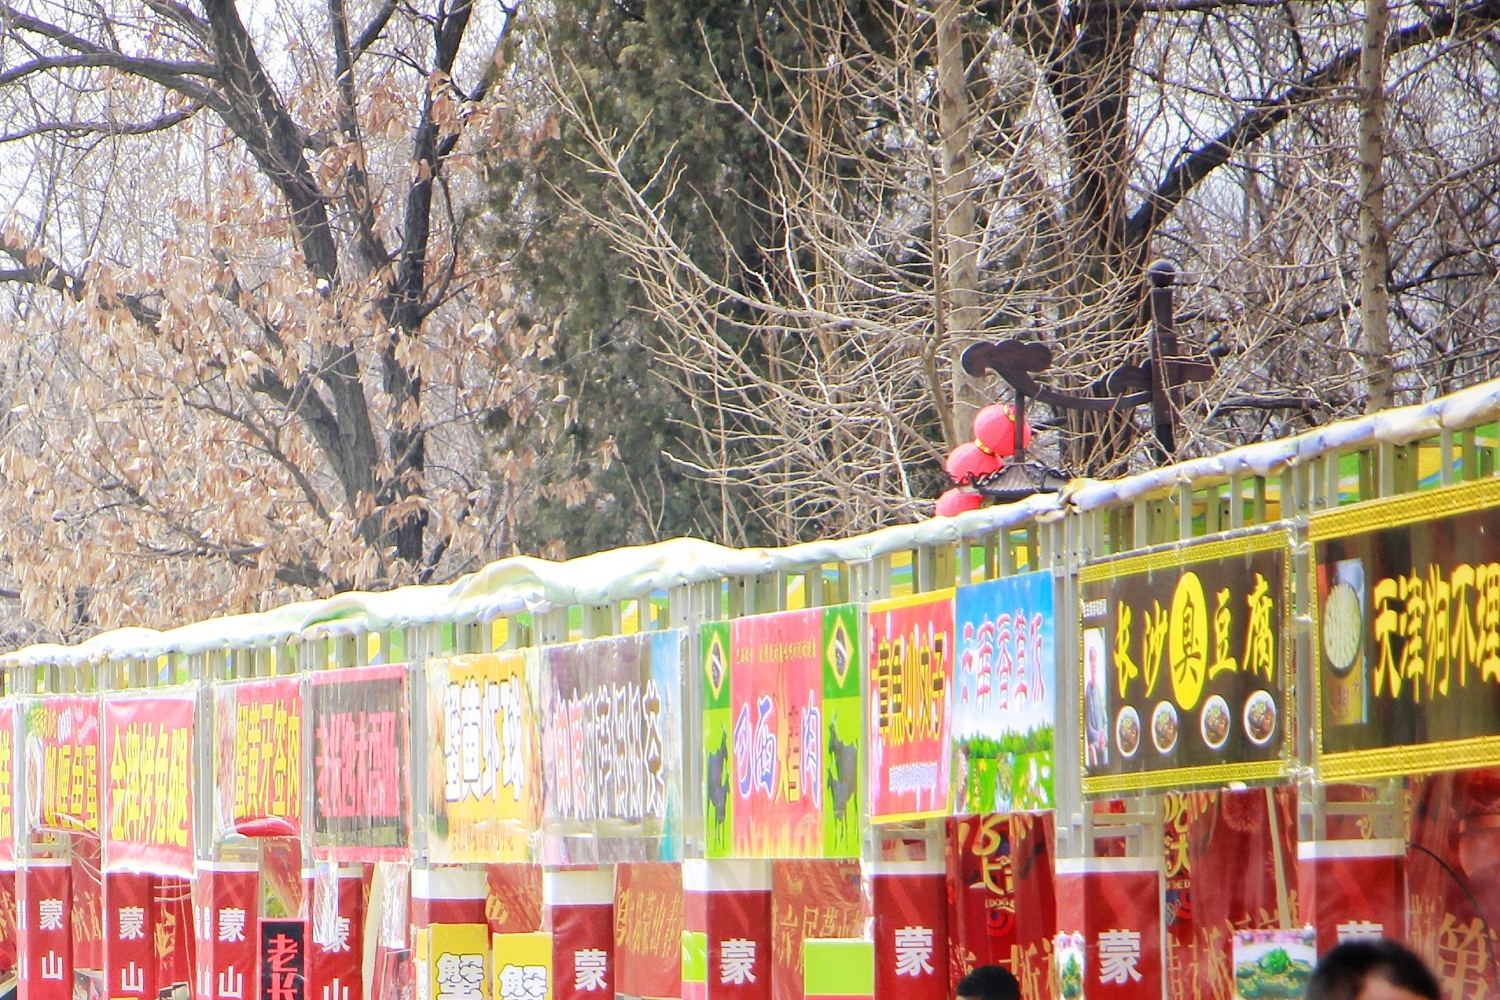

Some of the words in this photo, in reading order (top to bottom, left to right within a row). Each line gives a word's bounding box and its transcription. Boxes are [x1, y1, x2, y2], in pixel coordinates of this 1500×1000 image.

[1113, 573, 1276, 699] 长沙臭豆腐
